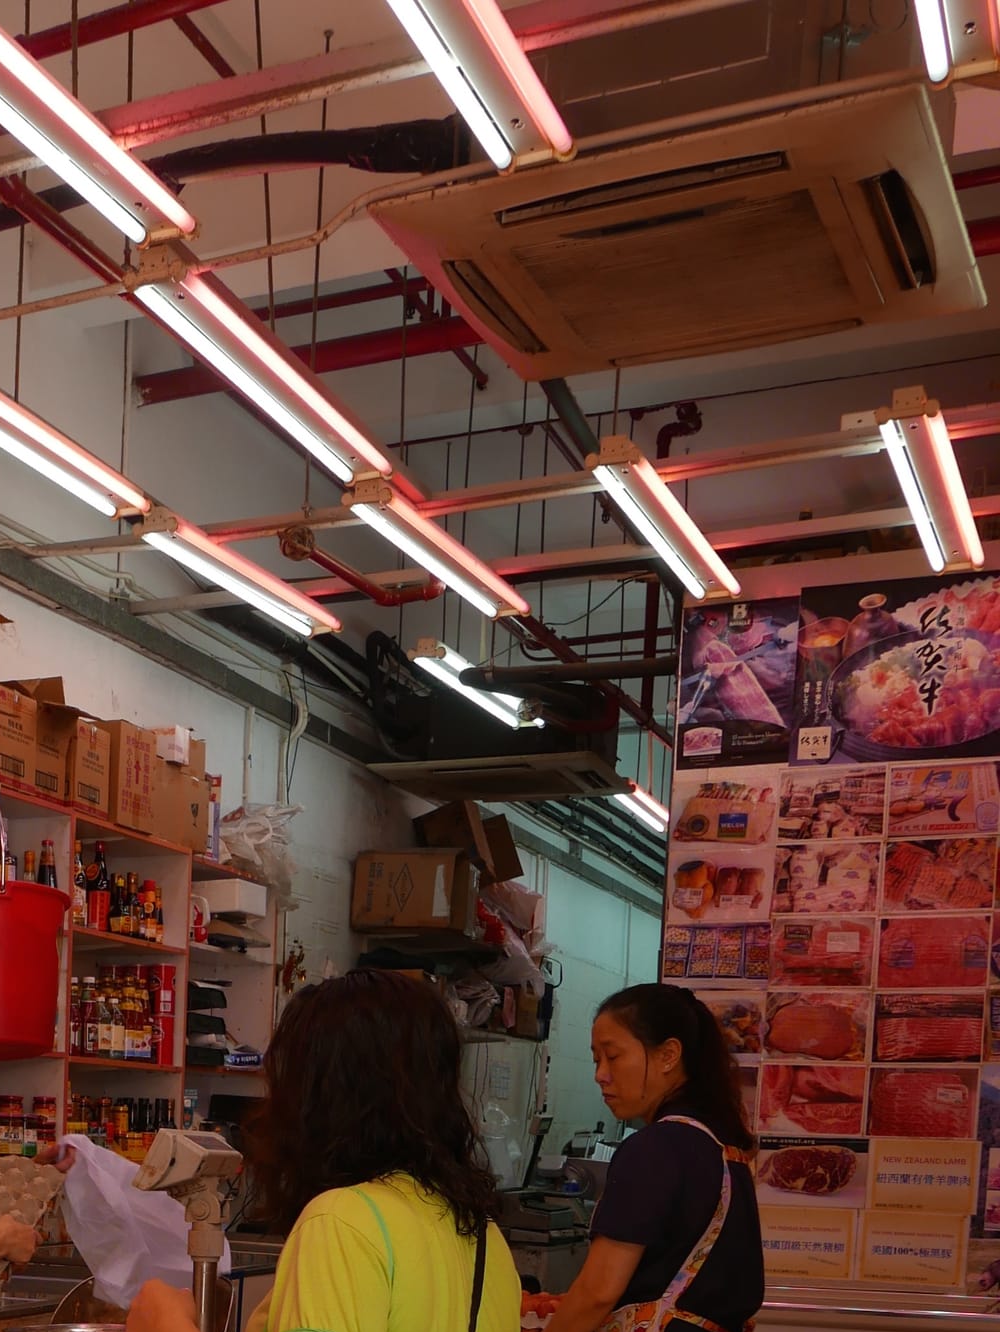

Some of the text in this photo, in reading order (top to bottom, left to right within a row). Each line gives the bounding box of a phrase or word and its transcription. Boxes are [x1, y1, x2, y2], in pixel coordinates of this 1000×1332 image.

[883, 1156, 967, 1166] NEW ZEALAND LAMB
